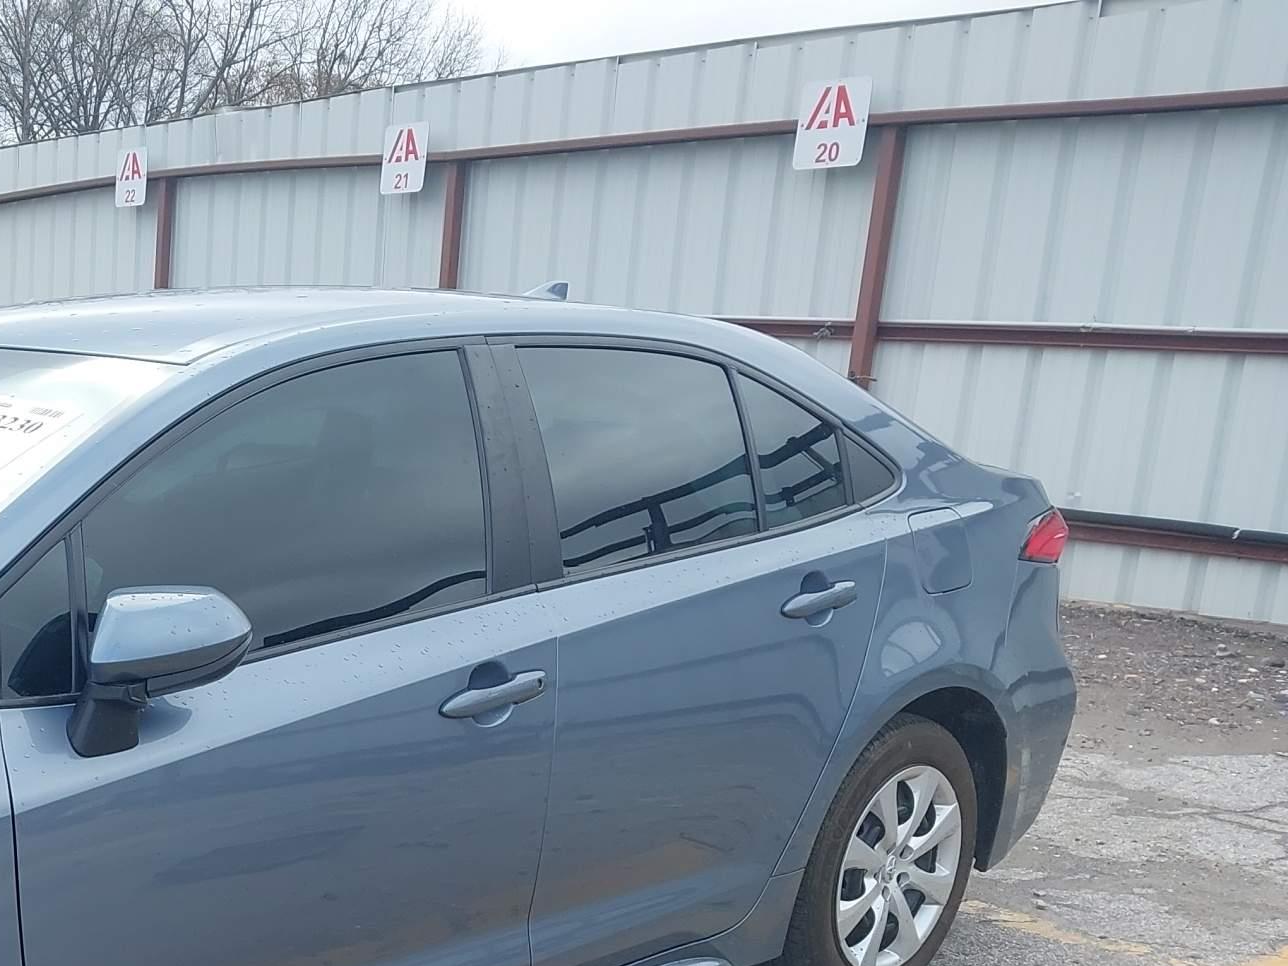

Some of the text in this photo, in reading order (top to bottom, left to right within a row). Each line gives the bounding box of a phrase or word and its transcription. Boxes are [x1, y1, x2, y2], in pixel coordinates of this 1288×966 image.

[814, 141, 840, 163] 20
[394, 172, 409, 190] 21
[125, 189, 136, 203] 22
